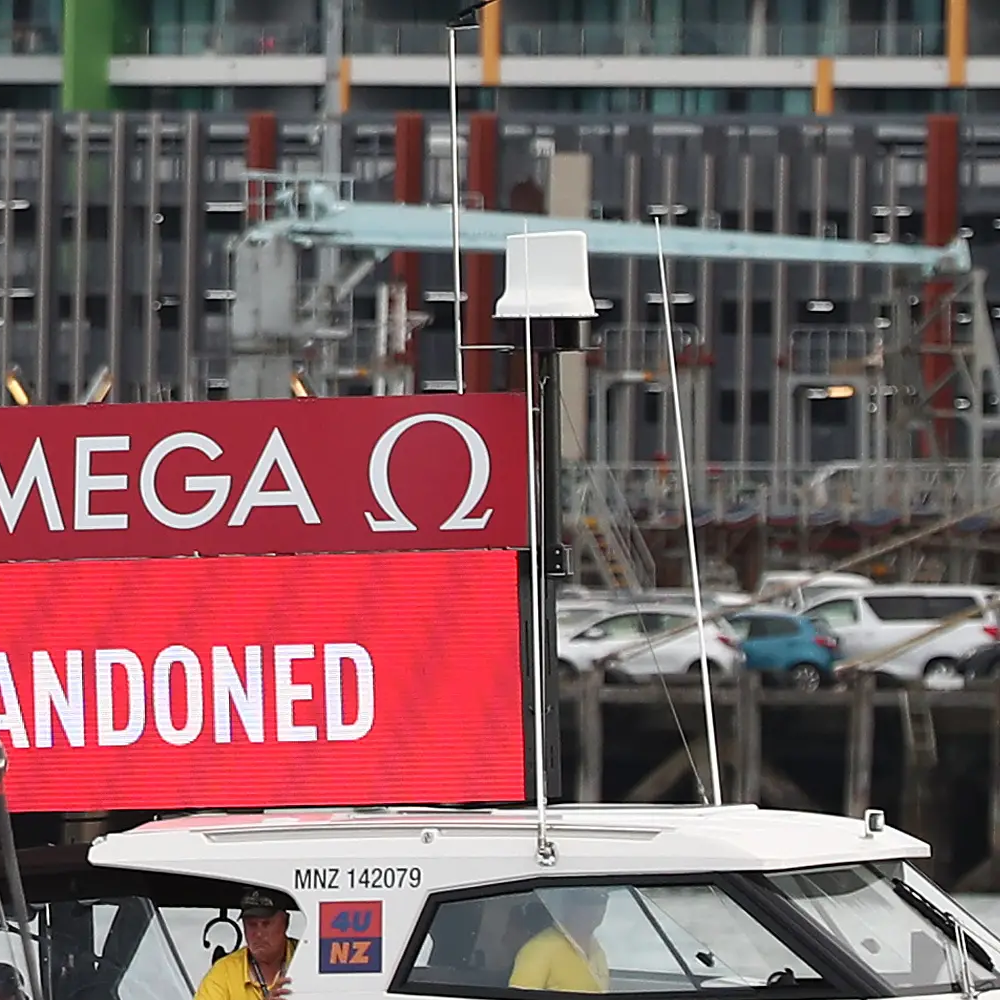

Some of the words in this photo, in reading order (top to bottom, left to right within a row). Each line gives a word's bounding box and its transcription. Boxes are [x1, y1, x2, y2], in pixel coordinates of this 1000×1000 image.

[295, 869, 339, 889] MNZ
[347, 867, 421, 888] 142079
[331, 911, 372, 932] 4U
[329, 941, 371, 964] NZ
